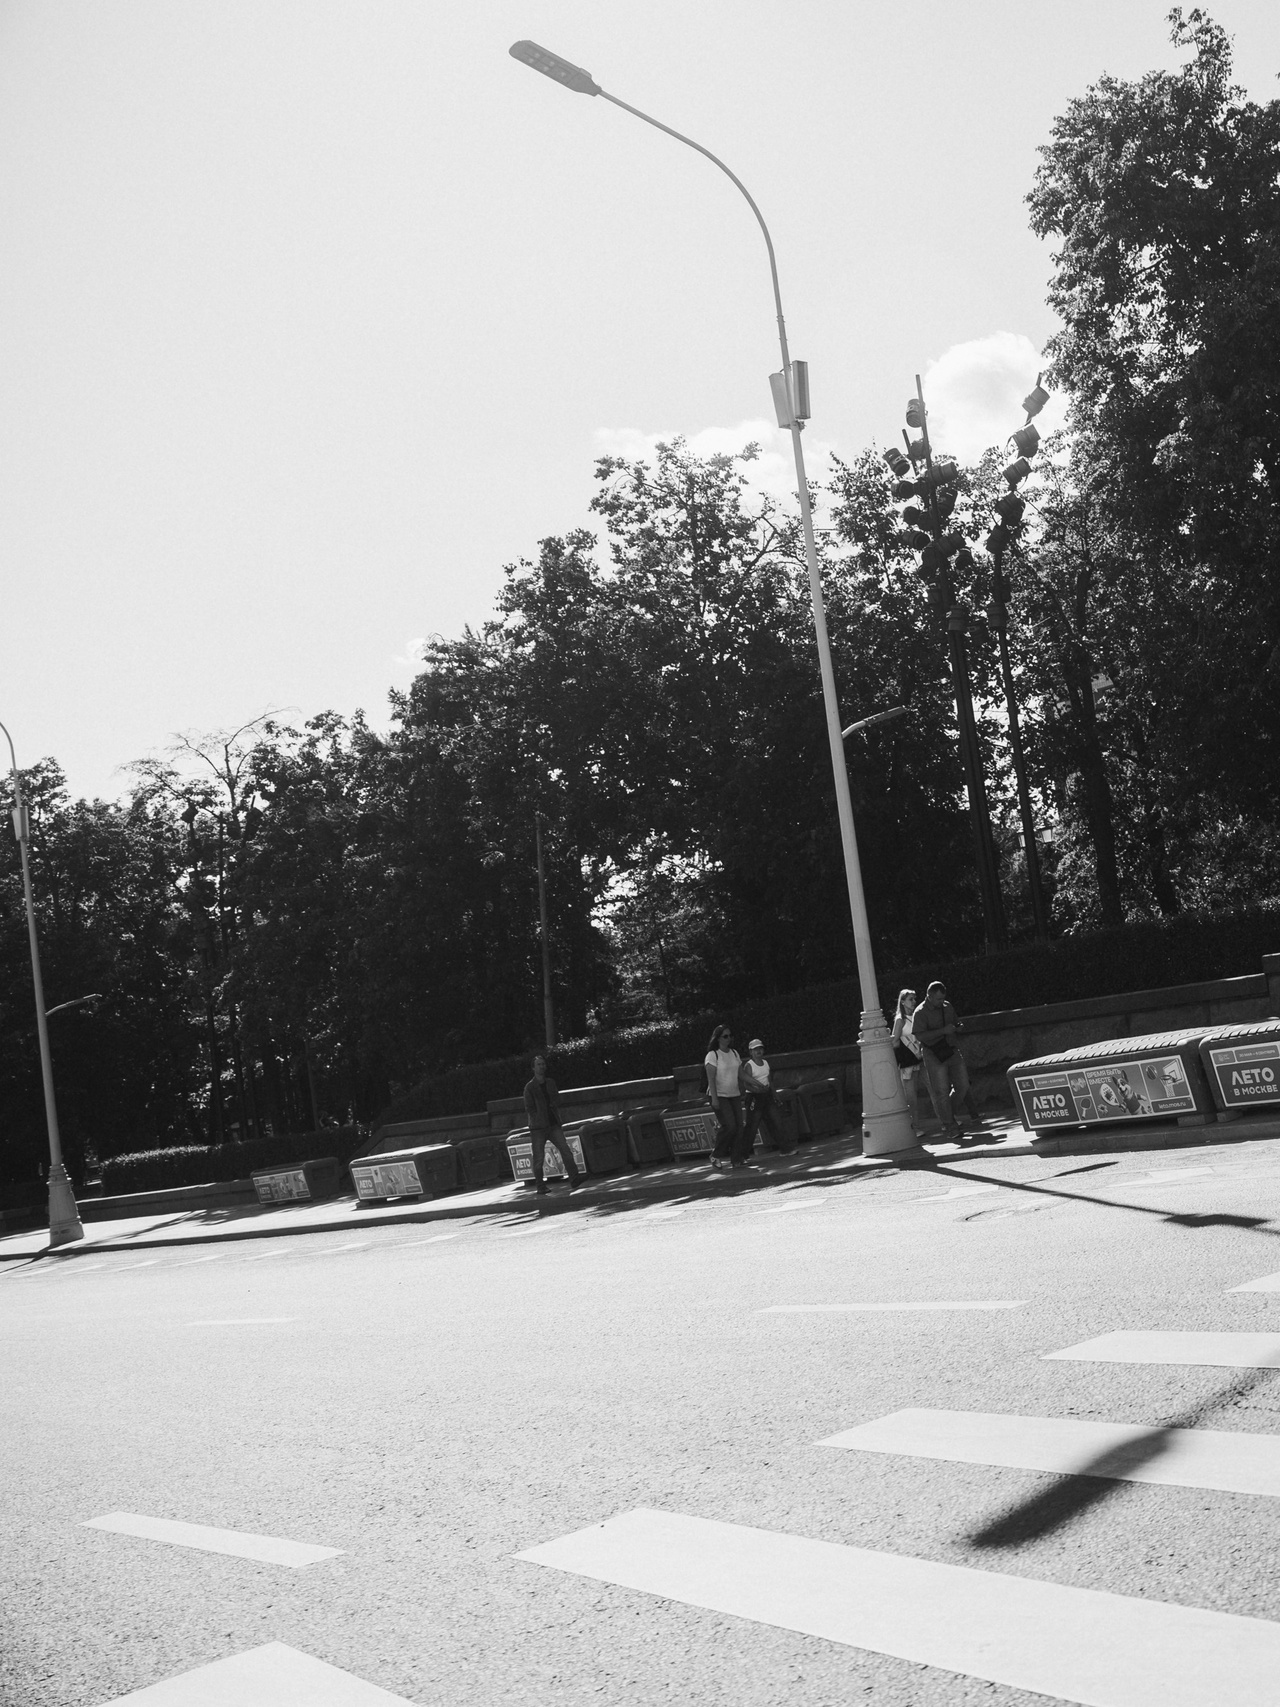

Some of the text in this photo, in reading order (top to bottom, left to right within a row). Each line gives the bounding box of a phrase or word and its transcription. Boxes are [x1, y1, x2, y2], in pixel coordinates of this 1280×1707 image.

[1086, 1070, 1107, 1078] ВРЕМЯ
[1232, 1067, 1274, 1085] ЛЕТО
[1088, 1076, 1111, 1085] ВМЕСТЕ
[1233, 1084, 1278, 1096] В МОСКВЕ
[1033, 1094, 1065, 1110] ЛЕТО
[1041, 1109, 1069, 1118] МОСКВЕ
[671, 1128, 695, 1142] ЛЕТО
[516, 1158, 531, 1169] ЛЕТО
